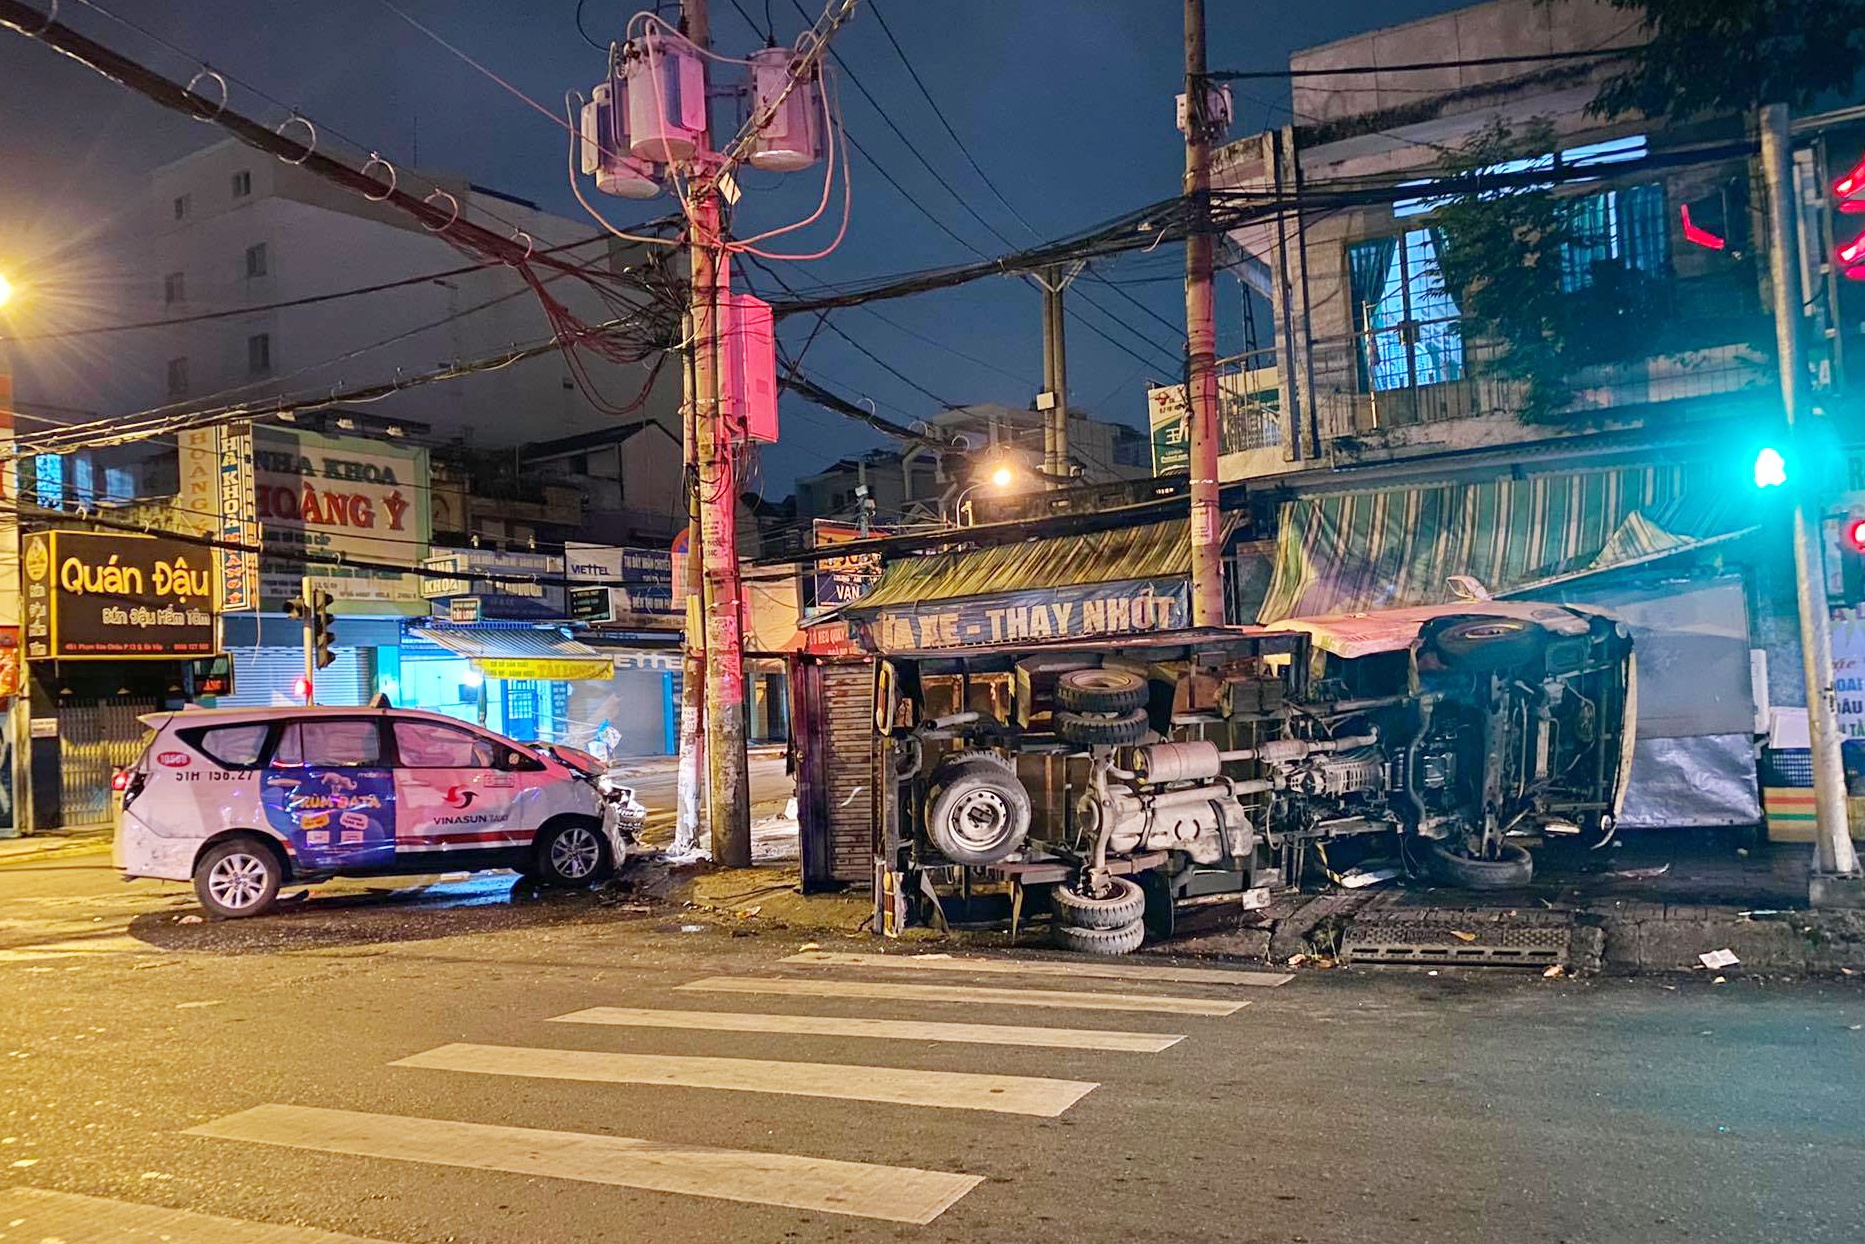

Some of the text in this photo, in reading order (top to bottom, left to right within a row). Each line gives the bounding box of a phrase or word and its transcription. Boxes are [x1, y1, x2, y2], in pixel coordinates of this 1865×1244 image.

[322, 457, 398, 486] KHOA
[382, 490, 410, 531] Ý
[61, 554, 143, 595] Quán
[152, 556, 210, 604] Đậu
[102, 606, 128, 624] Bún
[129, 606, 156, 628] Đậu
[186, 607, 211, 625] Tôm
[917, 612, 961, 648] XE
[986, 603, 1073, 640] THAY
[433, 814, 487, 825] VINASUN
